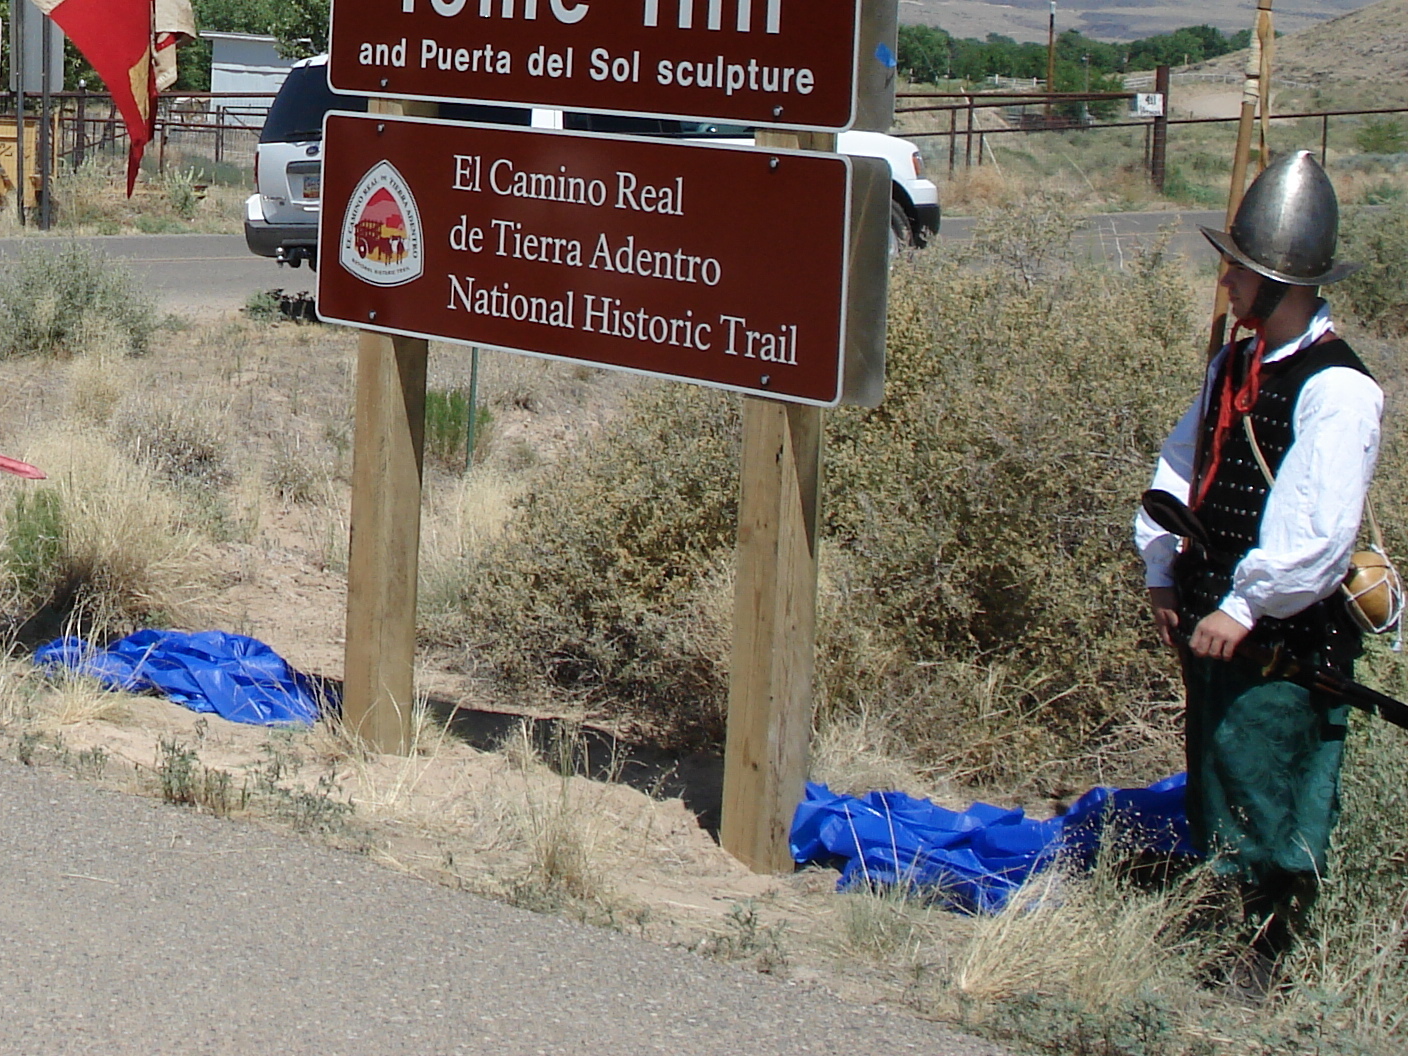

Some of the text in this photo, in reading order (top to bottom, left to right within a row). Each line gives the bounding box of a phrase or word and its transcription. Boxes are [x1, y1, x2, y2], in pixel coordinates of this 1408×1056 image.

[359, 37, 815, 96] and Puerta del Sol sculpture
[347, 196, 363, 234] CAMINO
[363, 178, 378, 196] REAL
[389, 177, 408, 209] TIERRA
[406, 209, 418, 259] ADENTRO
[452, 154, 684, 216] El Camino Real
[449, 214, 721, 286] de Tierra Adentro
[446, 274, 798, 366] National Historic Trail
